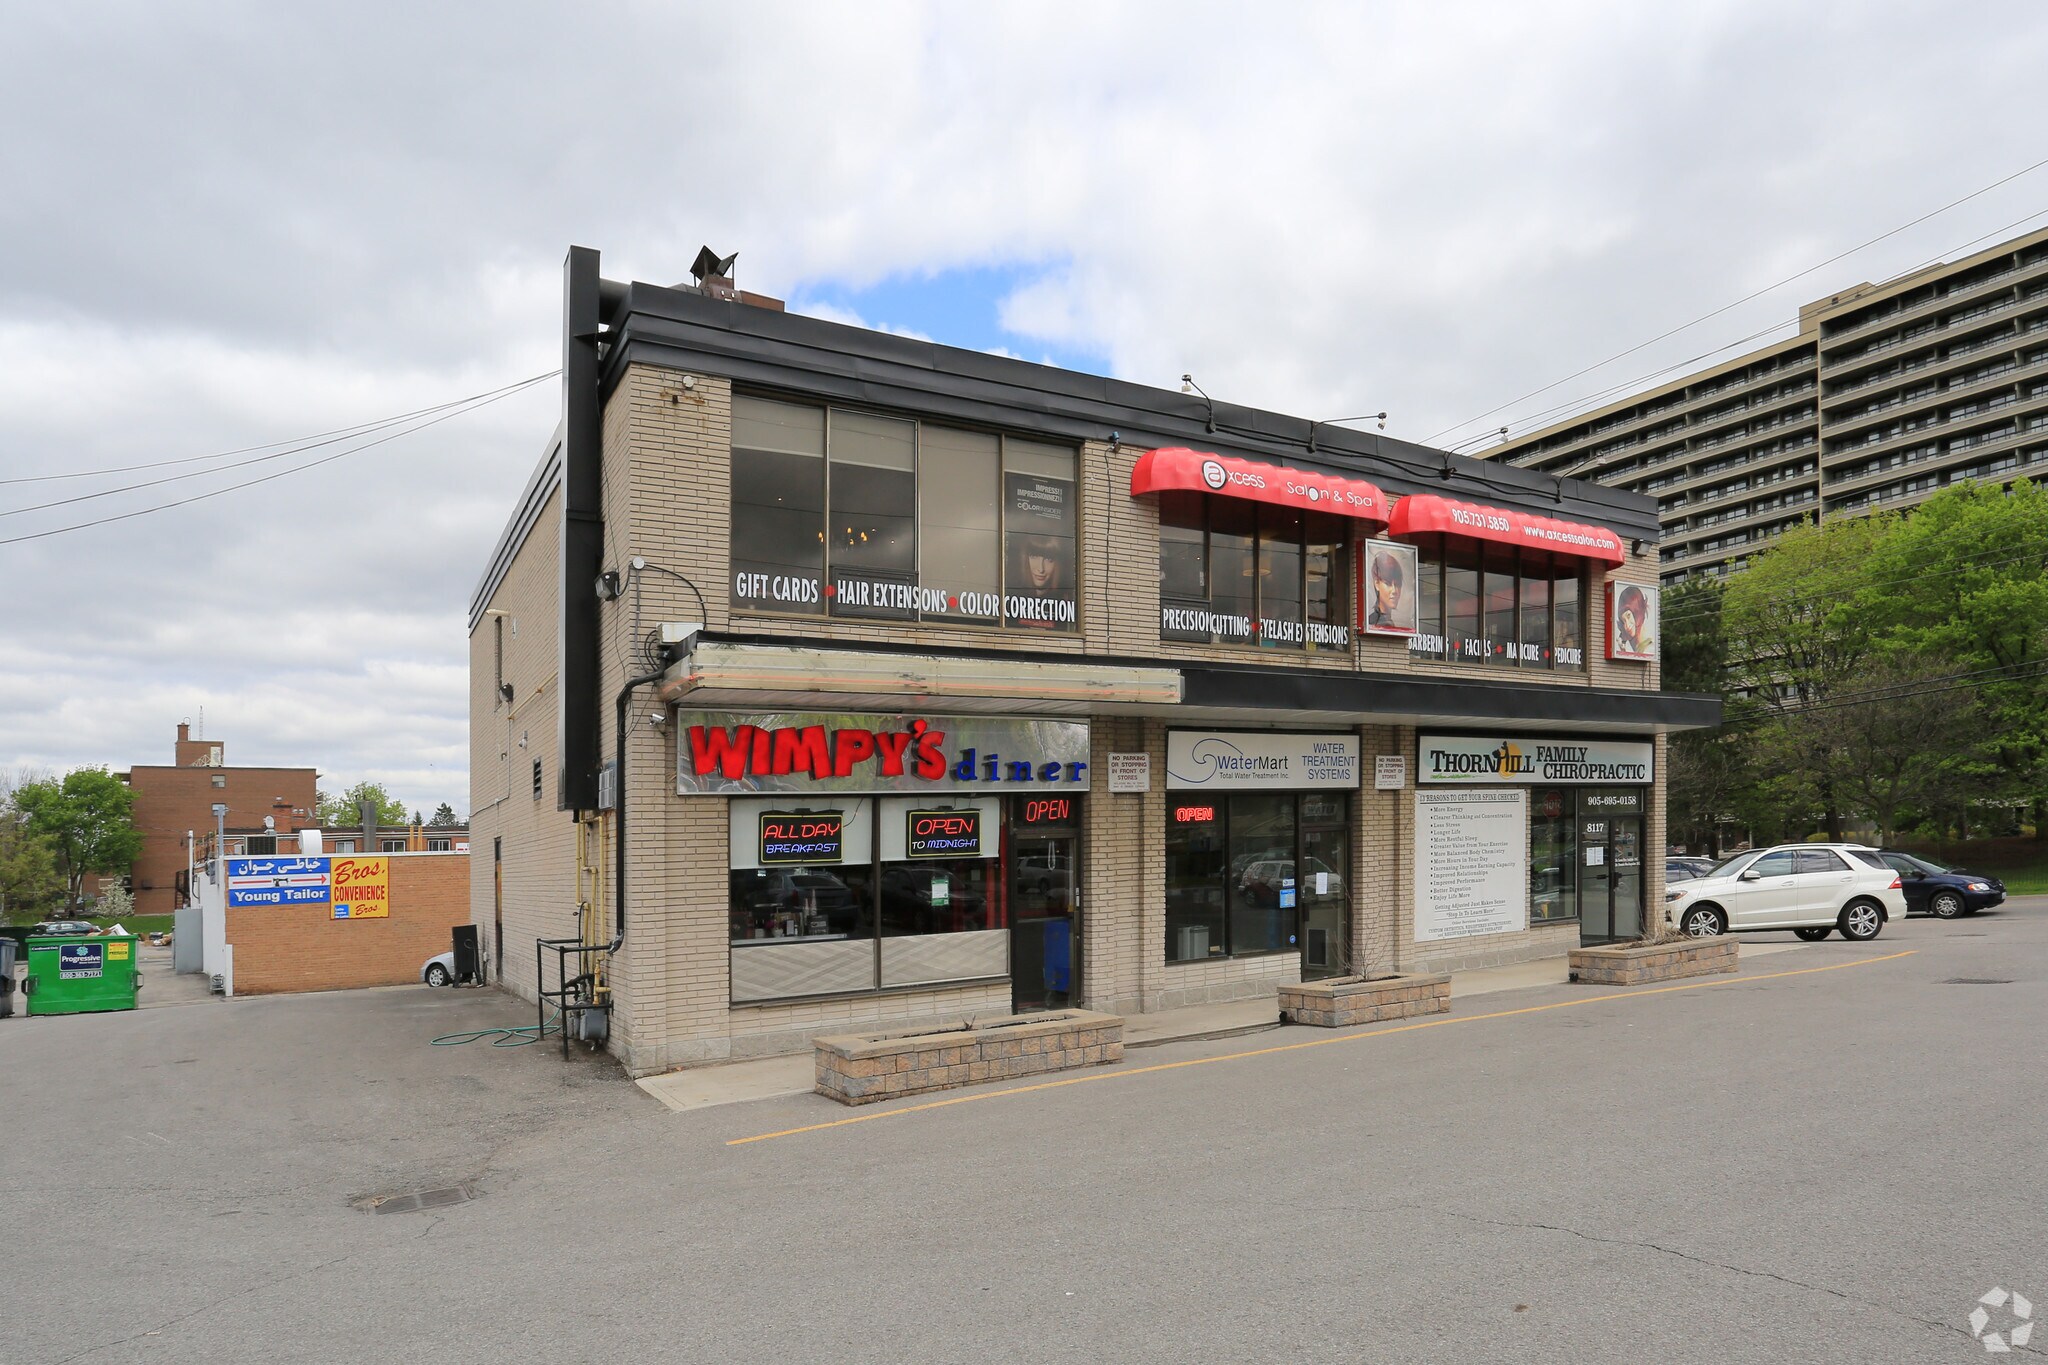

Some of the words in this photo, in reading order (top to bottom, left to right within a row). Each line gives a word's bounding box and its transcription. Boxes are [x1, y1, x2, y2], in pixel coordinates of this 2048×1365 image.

[1287, 481, 1330, 502] Salon
[1333, 490, 1343, 502] &
[1346, 491, 1372, 507] Spa
[1452, 508, 1509, 532] 905.731.5850
[1524, 524, 1614, 550] www.axcesssalon.com
[736, 572, 768, 599] GIFT
[772, 575, 818, 604] CARDS
[837, 580, 869, 606] HAIR
[873, 582, 947, 613] EXTENSIONS
[959, 592, 999, 617] COLOR
[1004, 596, 1075, 622] CORRECTION
[1163, 608, 1212, 632] PRECISION
[1211, 614, 1250, 636] CUTTING
[1260, 618, 1294, 641] EYELASH
[687, 719, 946, 780] WIMPY'S
[956, 748, 1086, 782] diner
[1313, 743, 1344, 753] WATER
[1536, 746, 1588, 762] FAMILY
[1217, 755, 1288, 770] WaterMart
[1302, 756, 1356, 766] TREATMENT
[1308, 769, 1350, 780] SYSTEMS
[1543, 763, 1645, 780] CHIROPRACTIC
[1588, 796, 1636, 805] 905-695-0158
[1026, 800, 1069, 822] OPEN
[1176, 807, 1214, 821] OPEN
[764, 825, 798, 839] ALL
[802, 823, 841, 838] DAY
[916, 818, 974, 835] OPEN
[1586, 823, 1604, 832] 8117
[765, 843, 838, 854] BREAKFAST
[912, 841, 925, 850] TO
[927, 839, 978, 848] MIDNIGHT
[334, 860, 386, 885] Bros.
[235, 891, 280, 902] Young
[284, 889, 325, 899] Tailor
[334, 885, 385, 901] CONVENIENCE
[62, 955, 101, 964] Progressive
